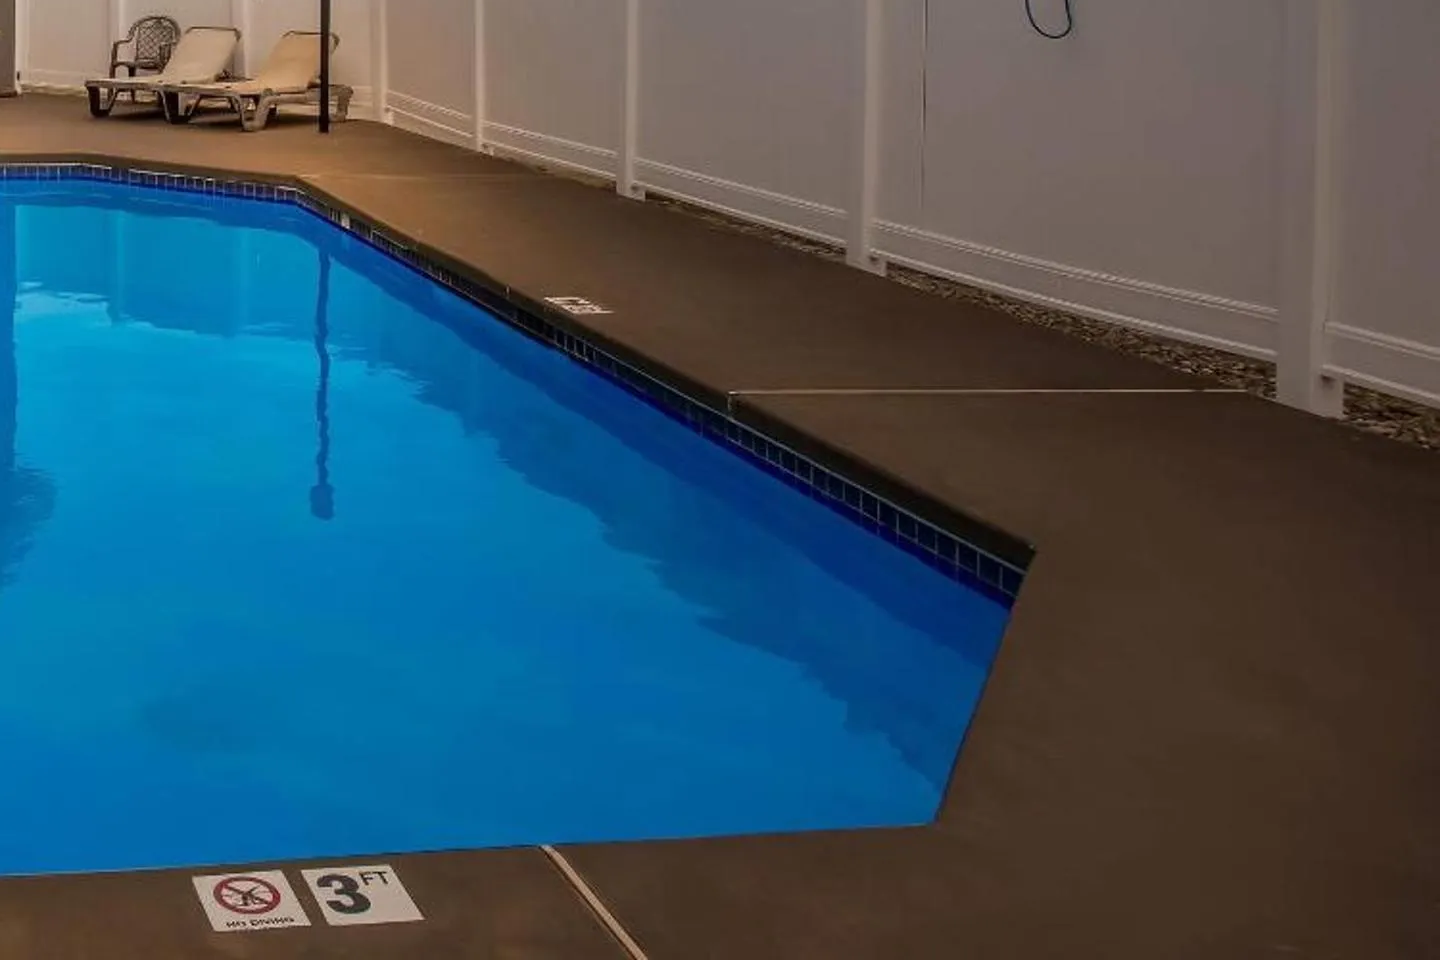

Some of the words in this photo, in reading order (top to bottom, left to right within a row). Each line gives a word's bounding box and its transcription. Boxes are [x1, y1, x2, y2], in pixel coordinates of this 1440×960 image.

[317, 874, 371, 914] 3
[359, 871, 389, 886] FT
[225, 920, 247, 928] NO
[250, 916, 295, 927] DIVING
